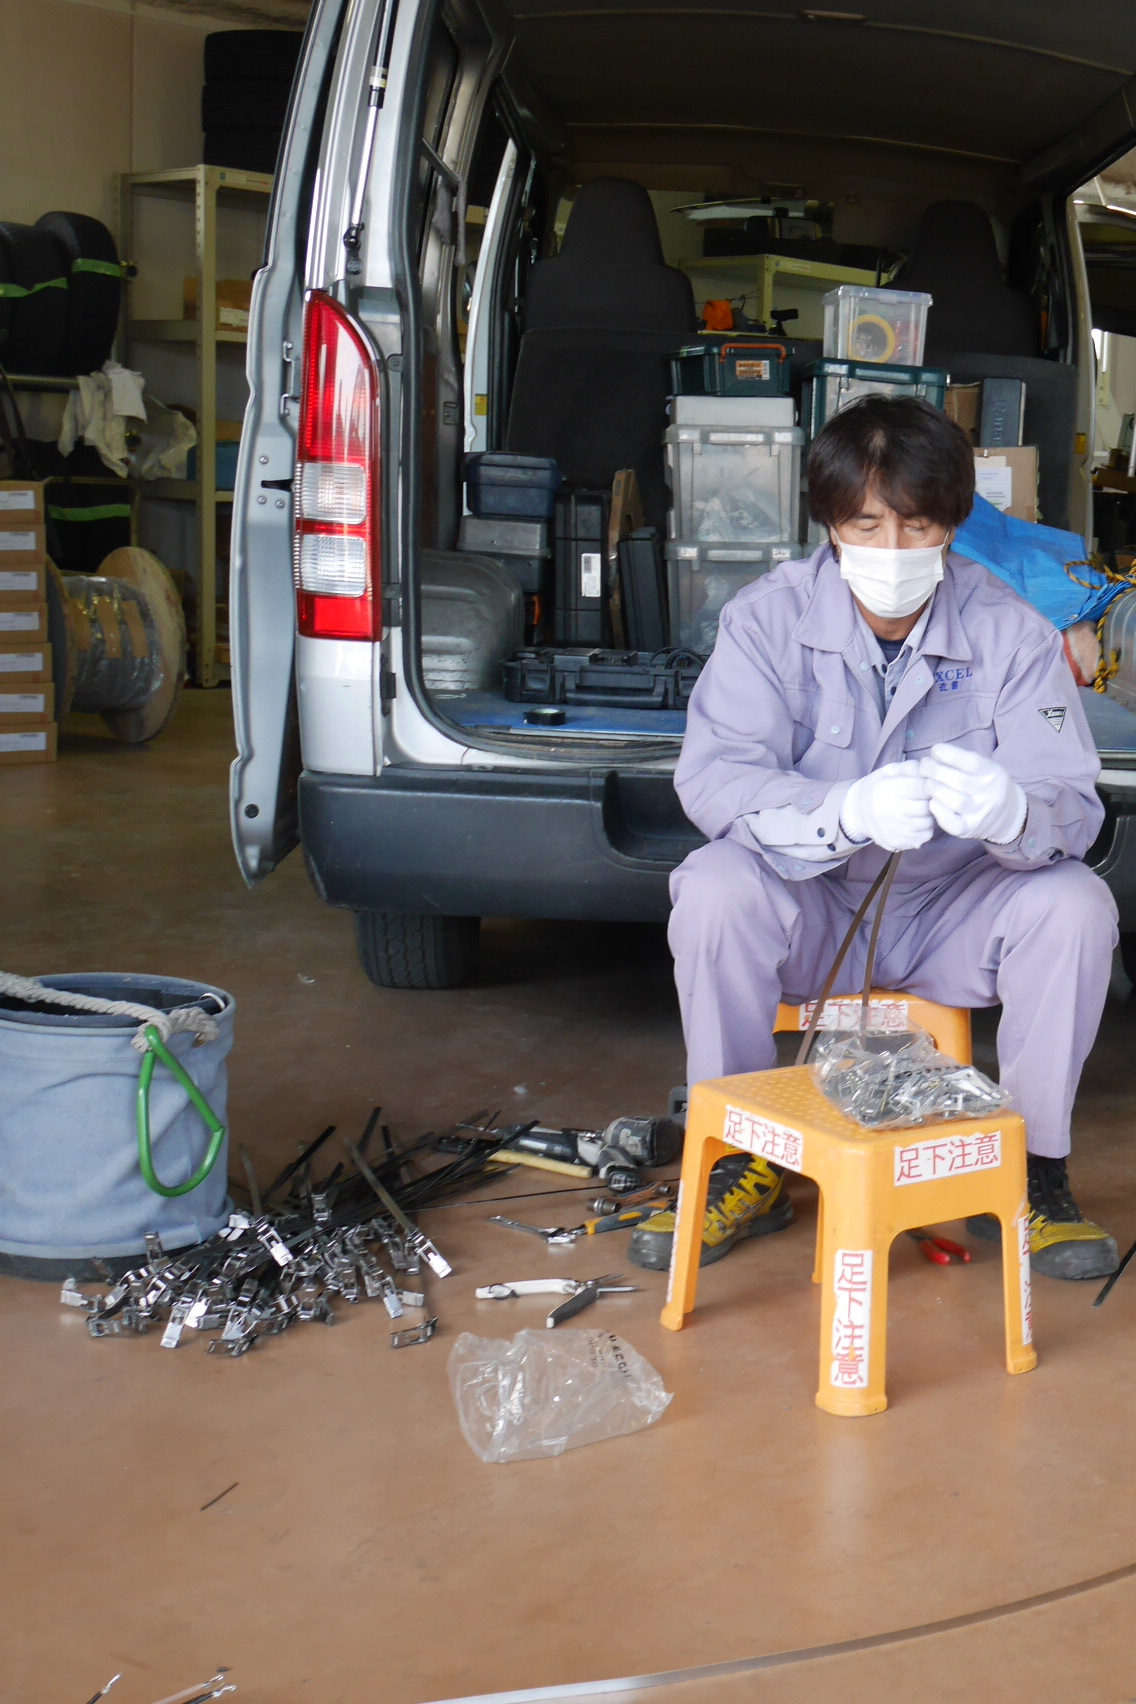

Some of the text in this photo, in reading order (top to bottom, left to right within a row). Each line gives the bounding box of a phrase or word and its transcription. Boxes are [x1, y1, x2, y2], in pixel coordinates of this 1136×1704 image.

[933, 667, 973, 682] XCEL
[726, 1110, 802, 1169] 足下注意
[898, 1134, 999, 1182] 足下注意
[834, 1253, 866, 1385] 足下注意
